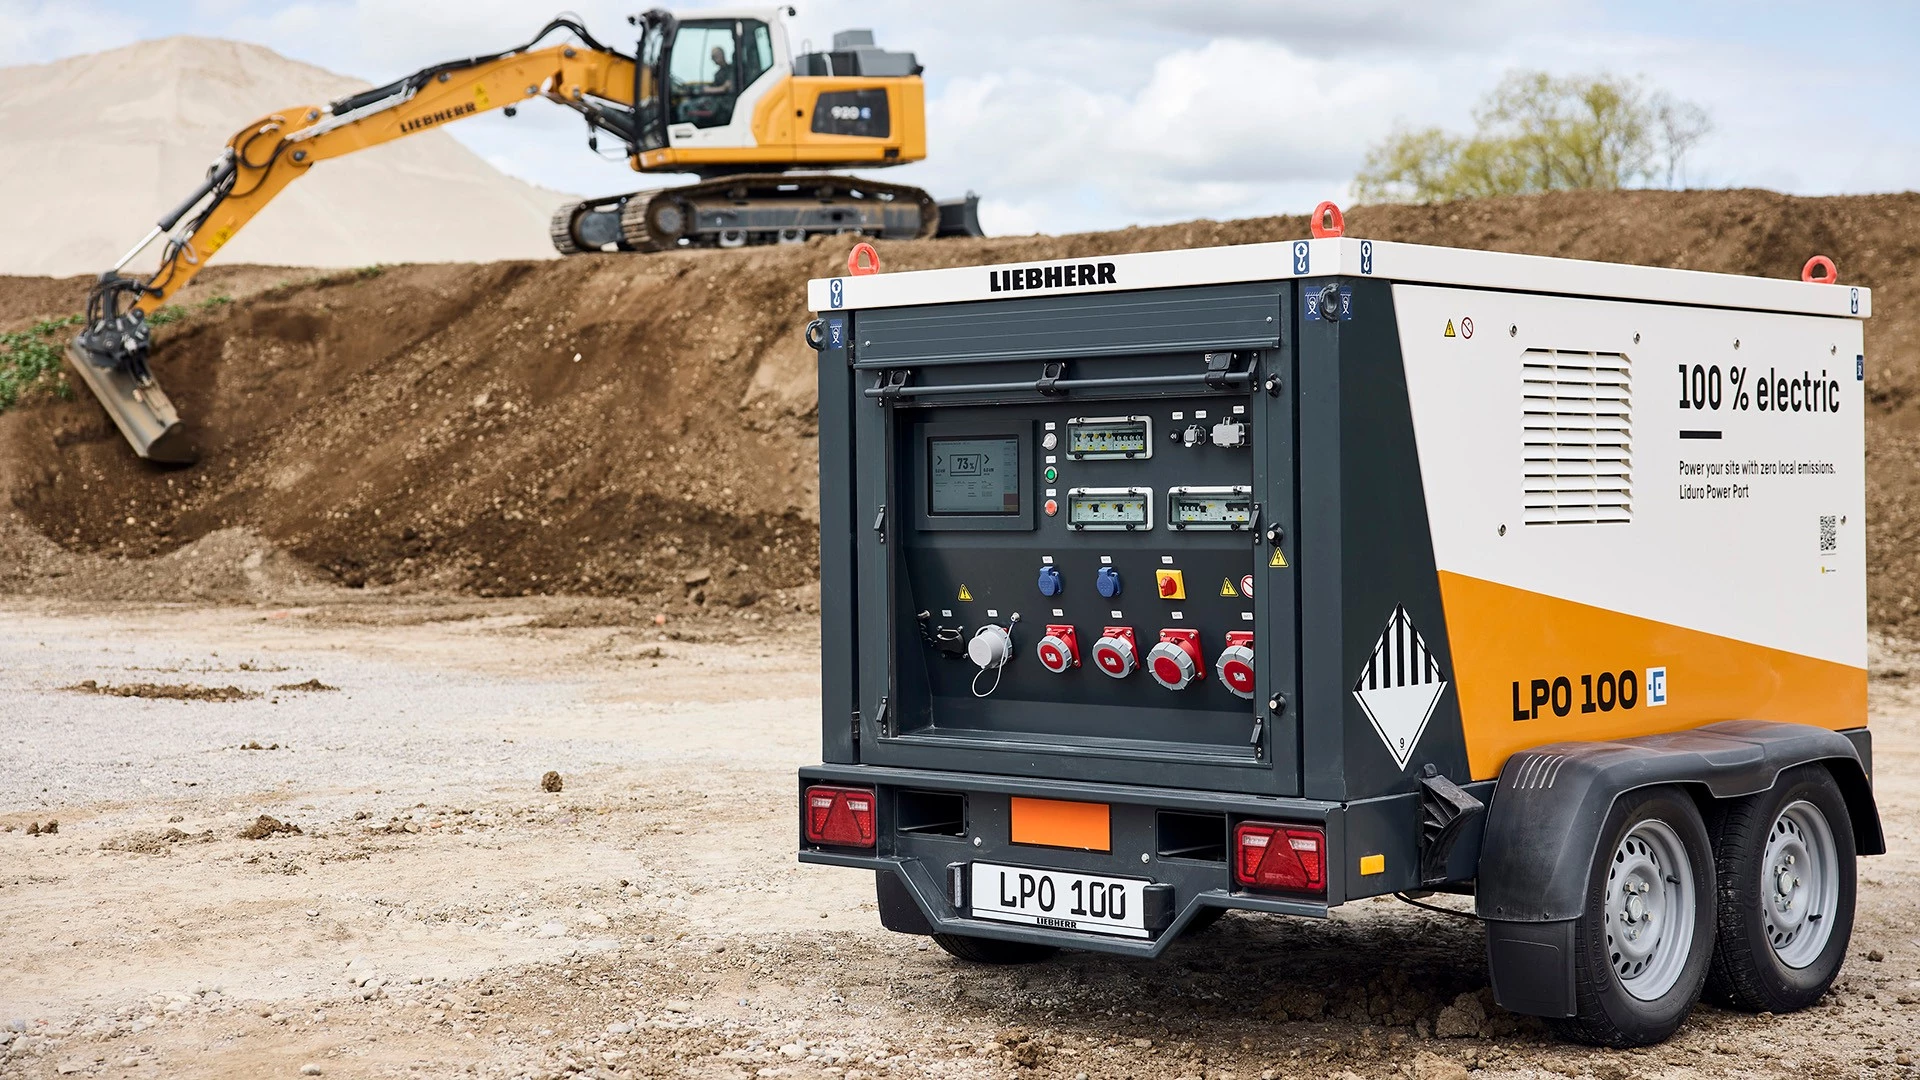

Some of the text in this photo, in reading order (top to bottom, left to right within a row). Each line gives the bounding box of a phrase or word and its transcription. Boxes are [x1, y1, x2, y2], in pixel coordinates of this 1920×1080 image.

[400, 102, 477, 132] LIEBHERR
[990, 262, 1117, 292] LIEBHERR
[1678, 364, 1840, 413] 100 % electric
[1679, 460, 1837, 478] Power your site with zero local emissions.
[1679, 484, 1749, 499] Liduro Power Port
[1512, 676, 1572, 721] LPO
[1581, 670, 1638, 713] 100
[1399, 737, 1405, 749] 9
[1000, 872, 1126, 920] LPO 100
[1036, 917, 1077, 929] LIEBHERR
